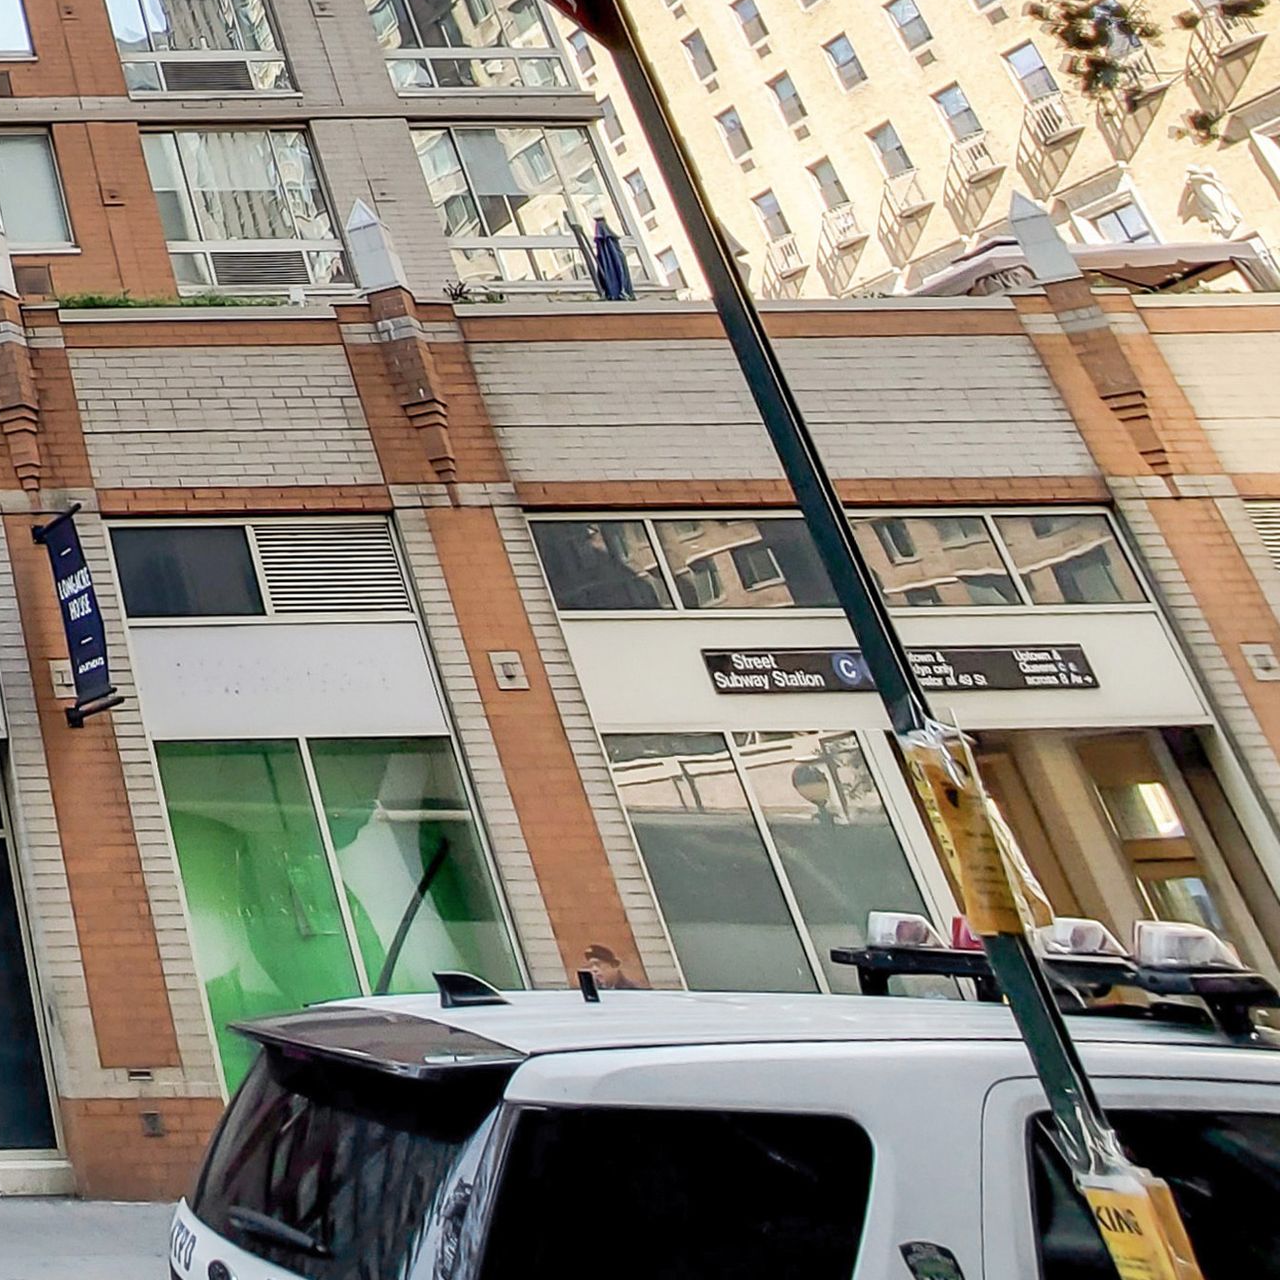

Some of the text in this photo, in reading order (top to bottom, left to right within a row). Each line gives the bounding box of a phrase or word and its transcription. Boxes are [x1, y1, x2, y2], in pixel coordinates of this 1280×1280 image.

[57, 566, 92, 601] LONGACRE
[68, 592, 92, 621] HOUSE
[731, 653, 778, 669] Street
[839, 658, 857, 679] C
[714, 669, 826, 689] Subway Station
